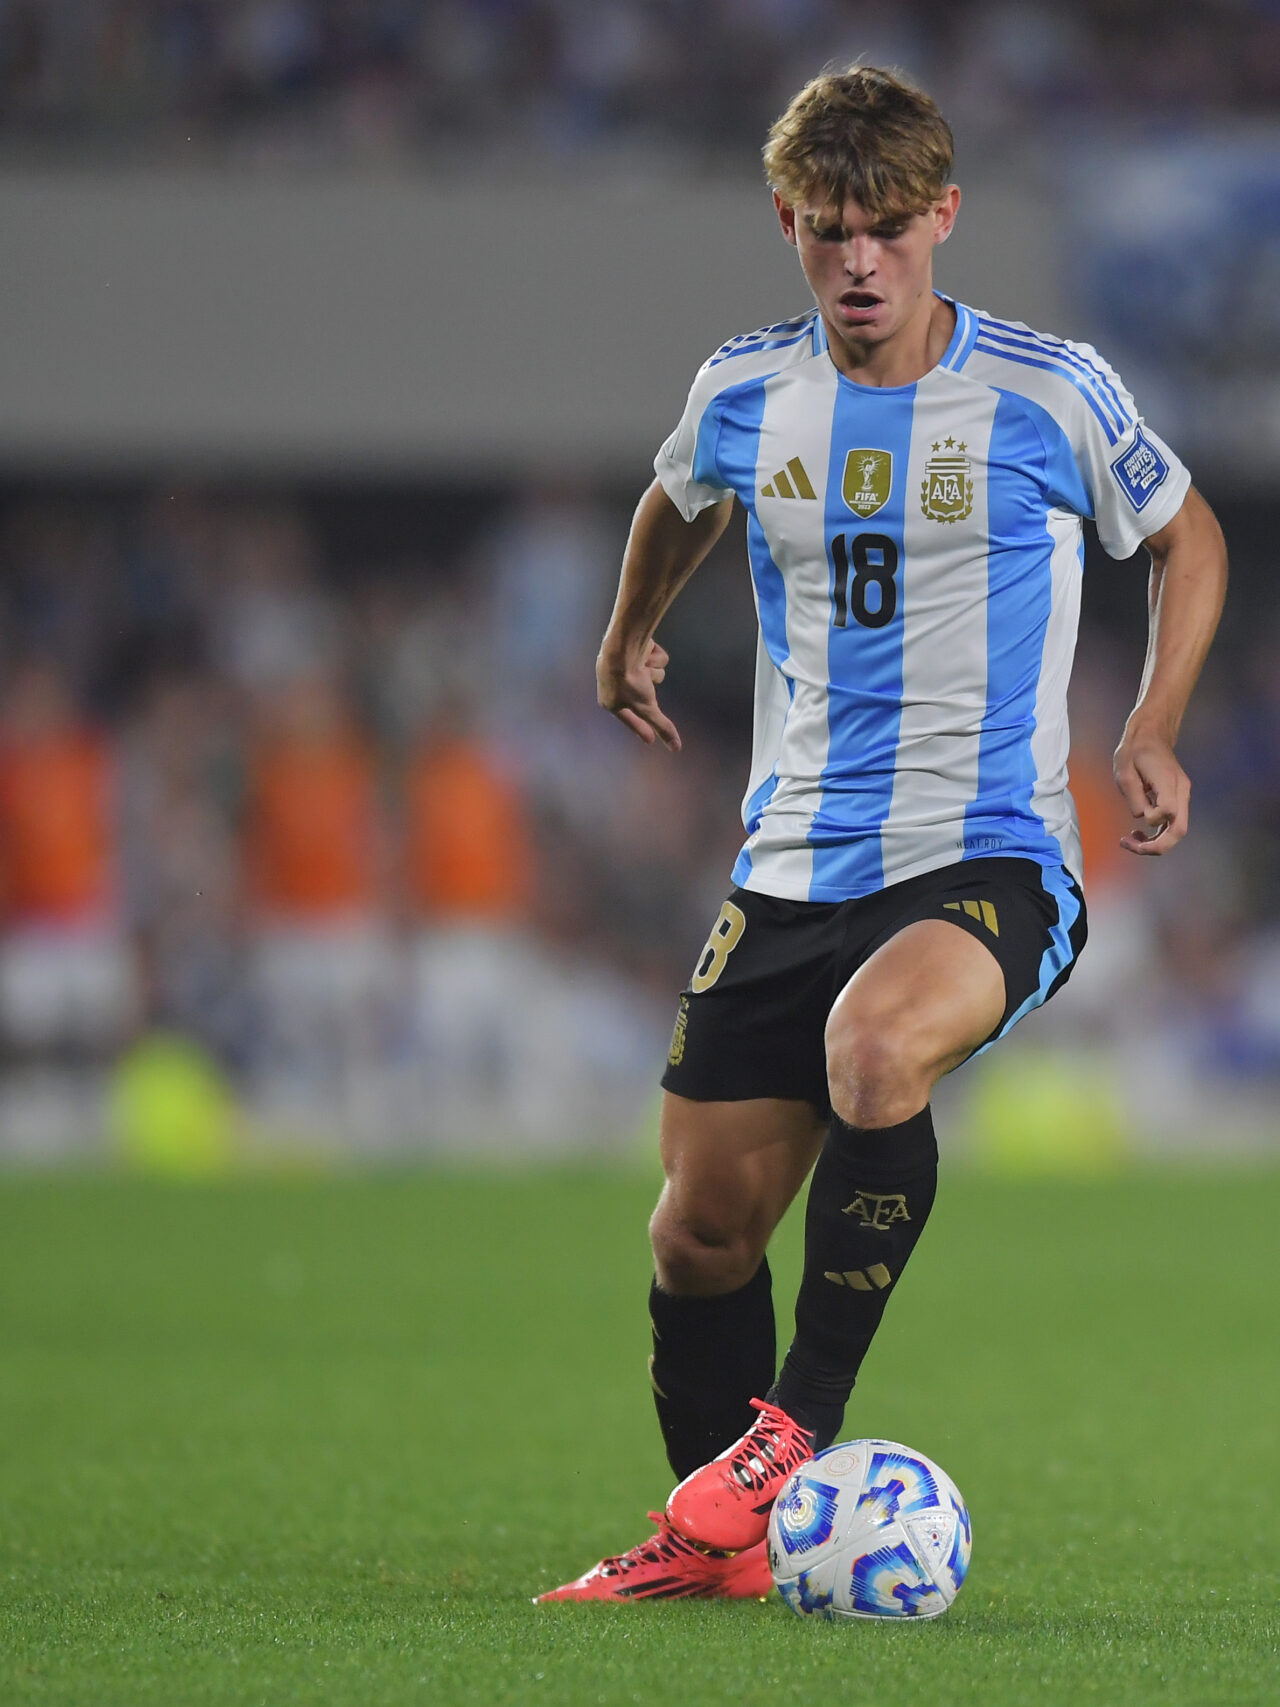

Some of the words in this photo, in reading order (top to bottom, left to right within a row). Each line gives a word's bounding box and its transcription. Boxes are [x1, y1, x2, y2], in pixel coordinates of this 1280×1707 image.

[1126, 450, 1153, 479] UNITES
[855, 492, 877, 501] FIFA
[931, 475, 962, 505] AFA
[830, 533, 898, 629] 18
[841, 1190, 912, 1231] AFA
